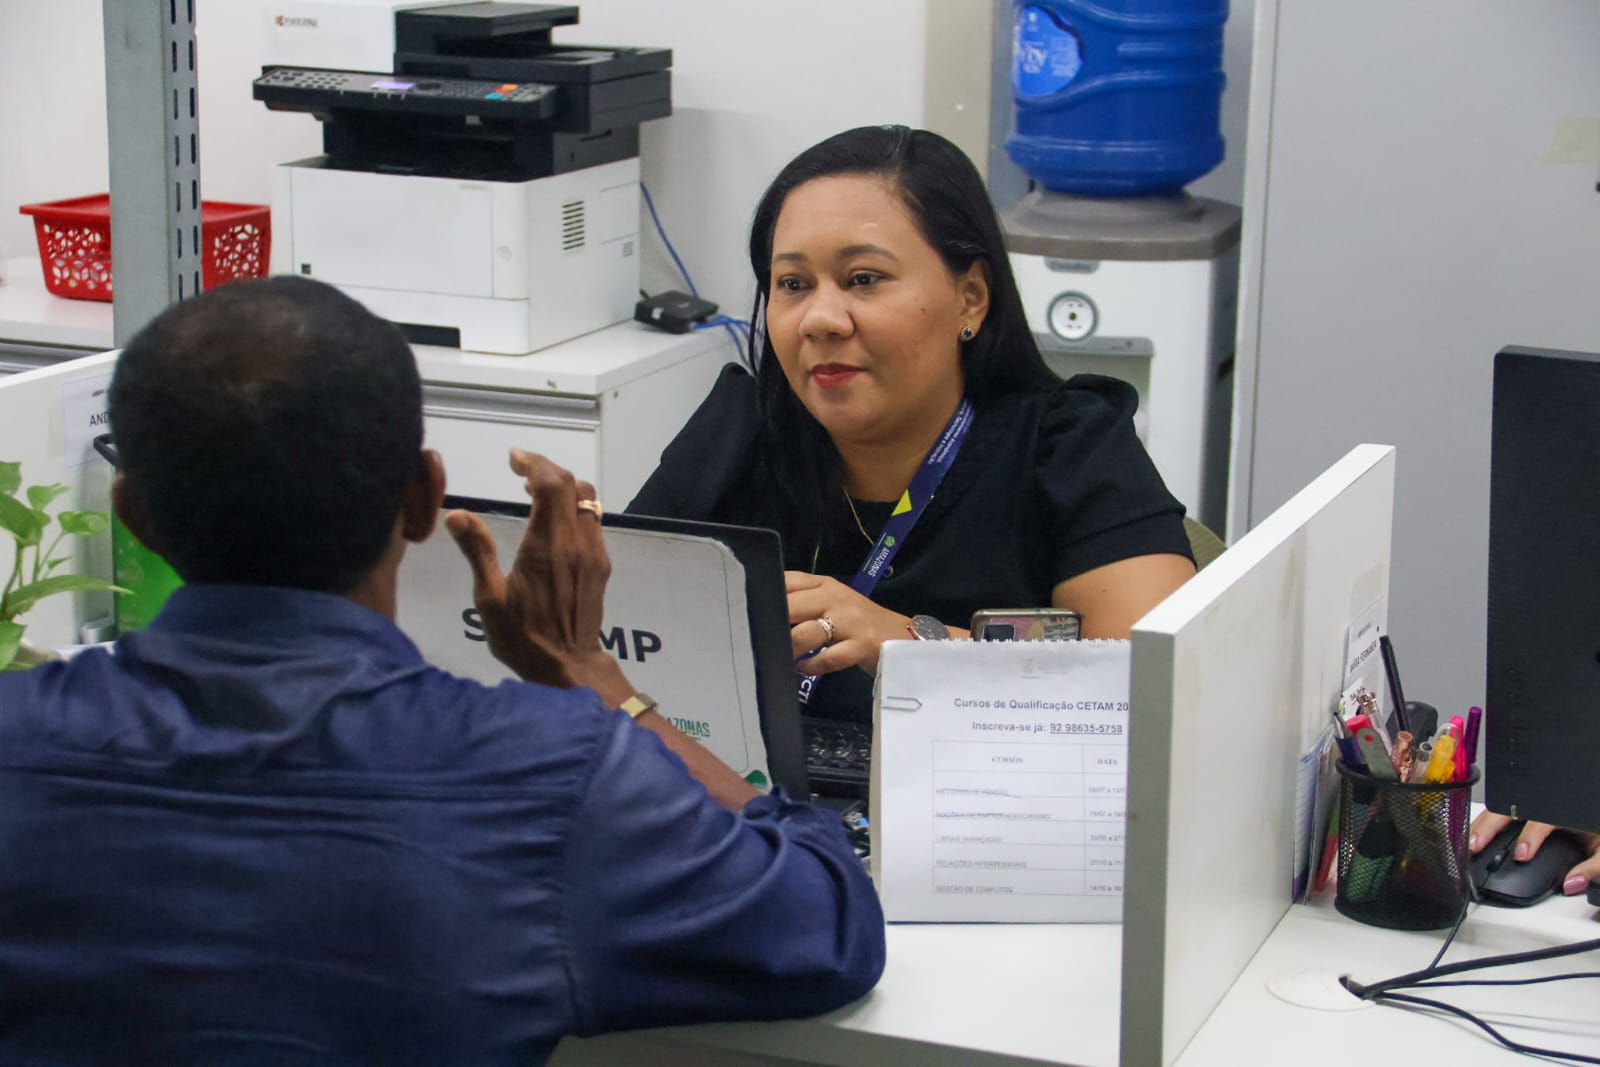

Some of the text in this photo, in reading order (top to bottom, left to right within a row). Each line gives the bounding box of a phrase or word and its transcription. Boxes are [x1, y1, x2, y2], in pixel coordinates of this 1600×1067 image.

[867, 546, 890, 578] AMAZONAS
[953, 697, 991, 709] Cursos
[993, 699, 1006, 710] de
[1008, 700, 1074, 713] Qualificação
[1076, 702, 1114, 712] CETAM
[971, 721, 1123, 734] Inscreva-se já: 92 98635-5758
